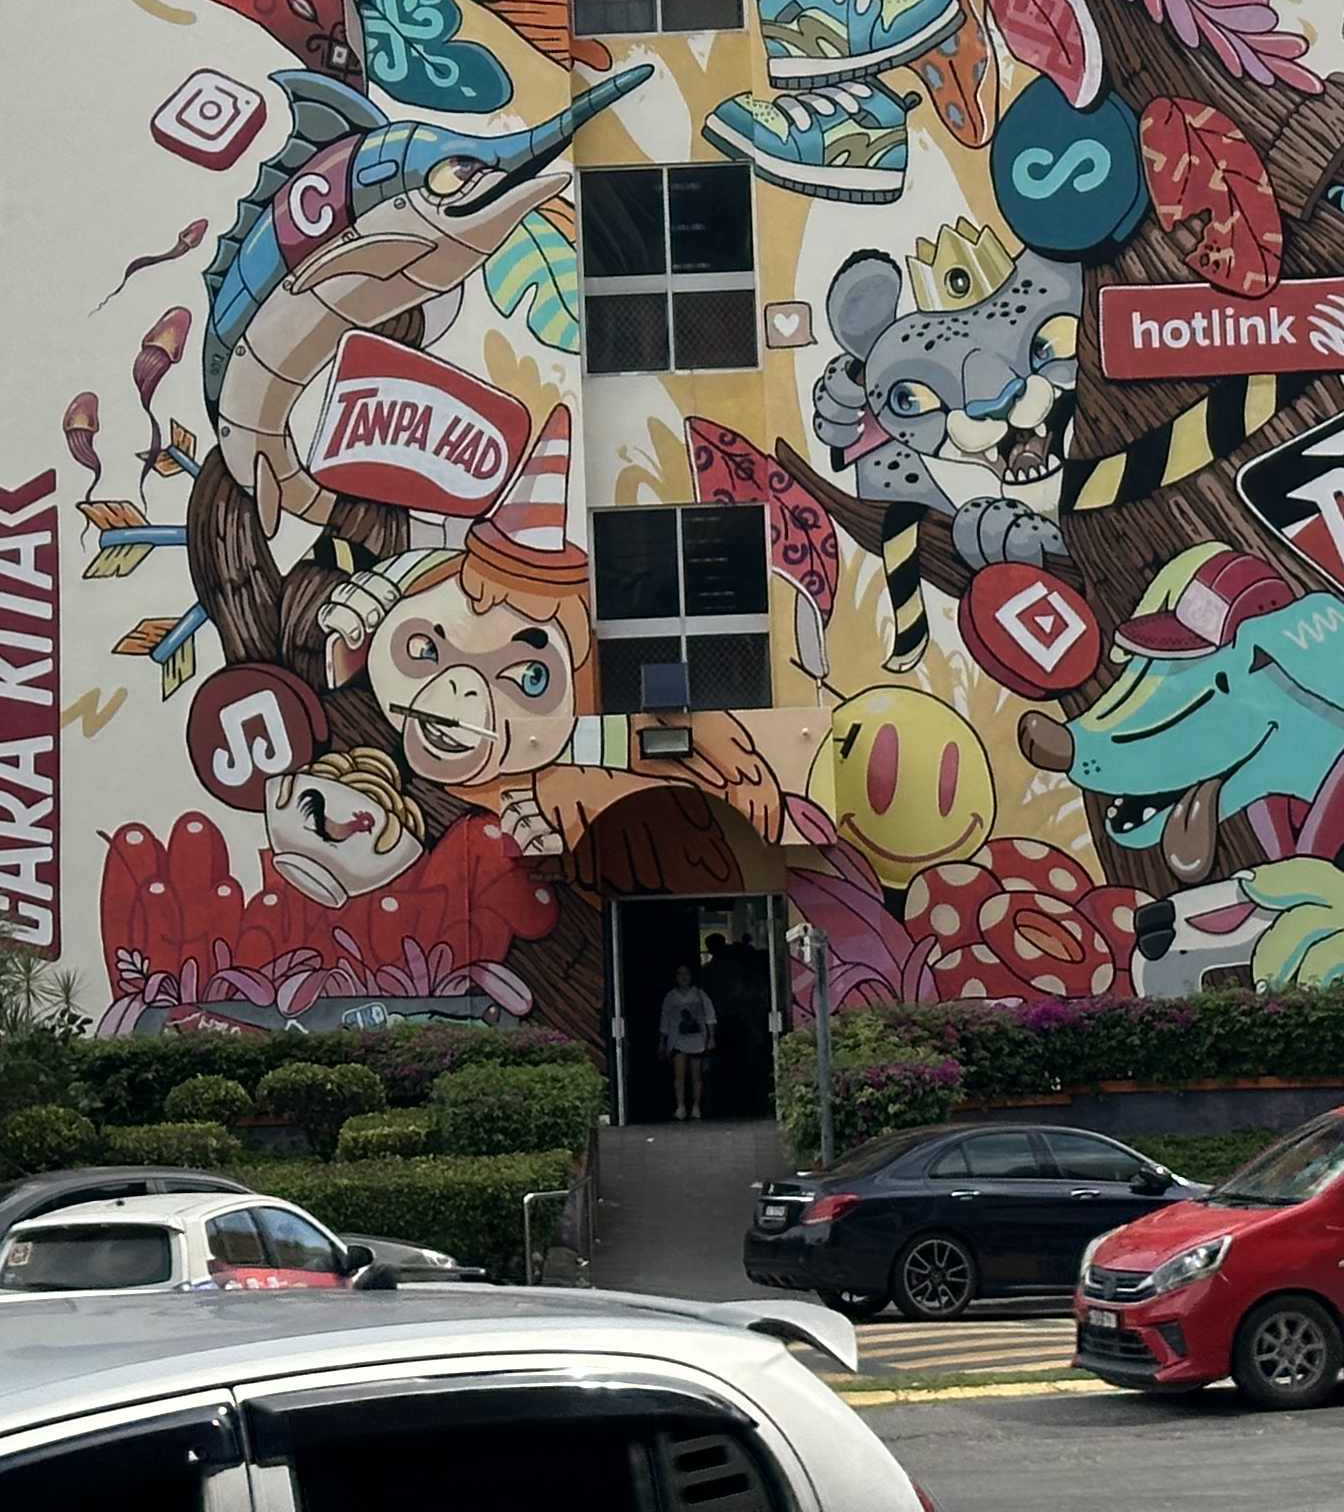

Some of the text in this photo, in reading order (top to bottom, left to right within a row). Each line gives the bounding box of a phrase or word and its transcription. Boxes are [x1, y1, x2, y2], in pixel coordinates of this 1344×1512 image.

[1130, 306, 1296, 350] hotlink
[323, 387, 502, 481] TANPA HAD
